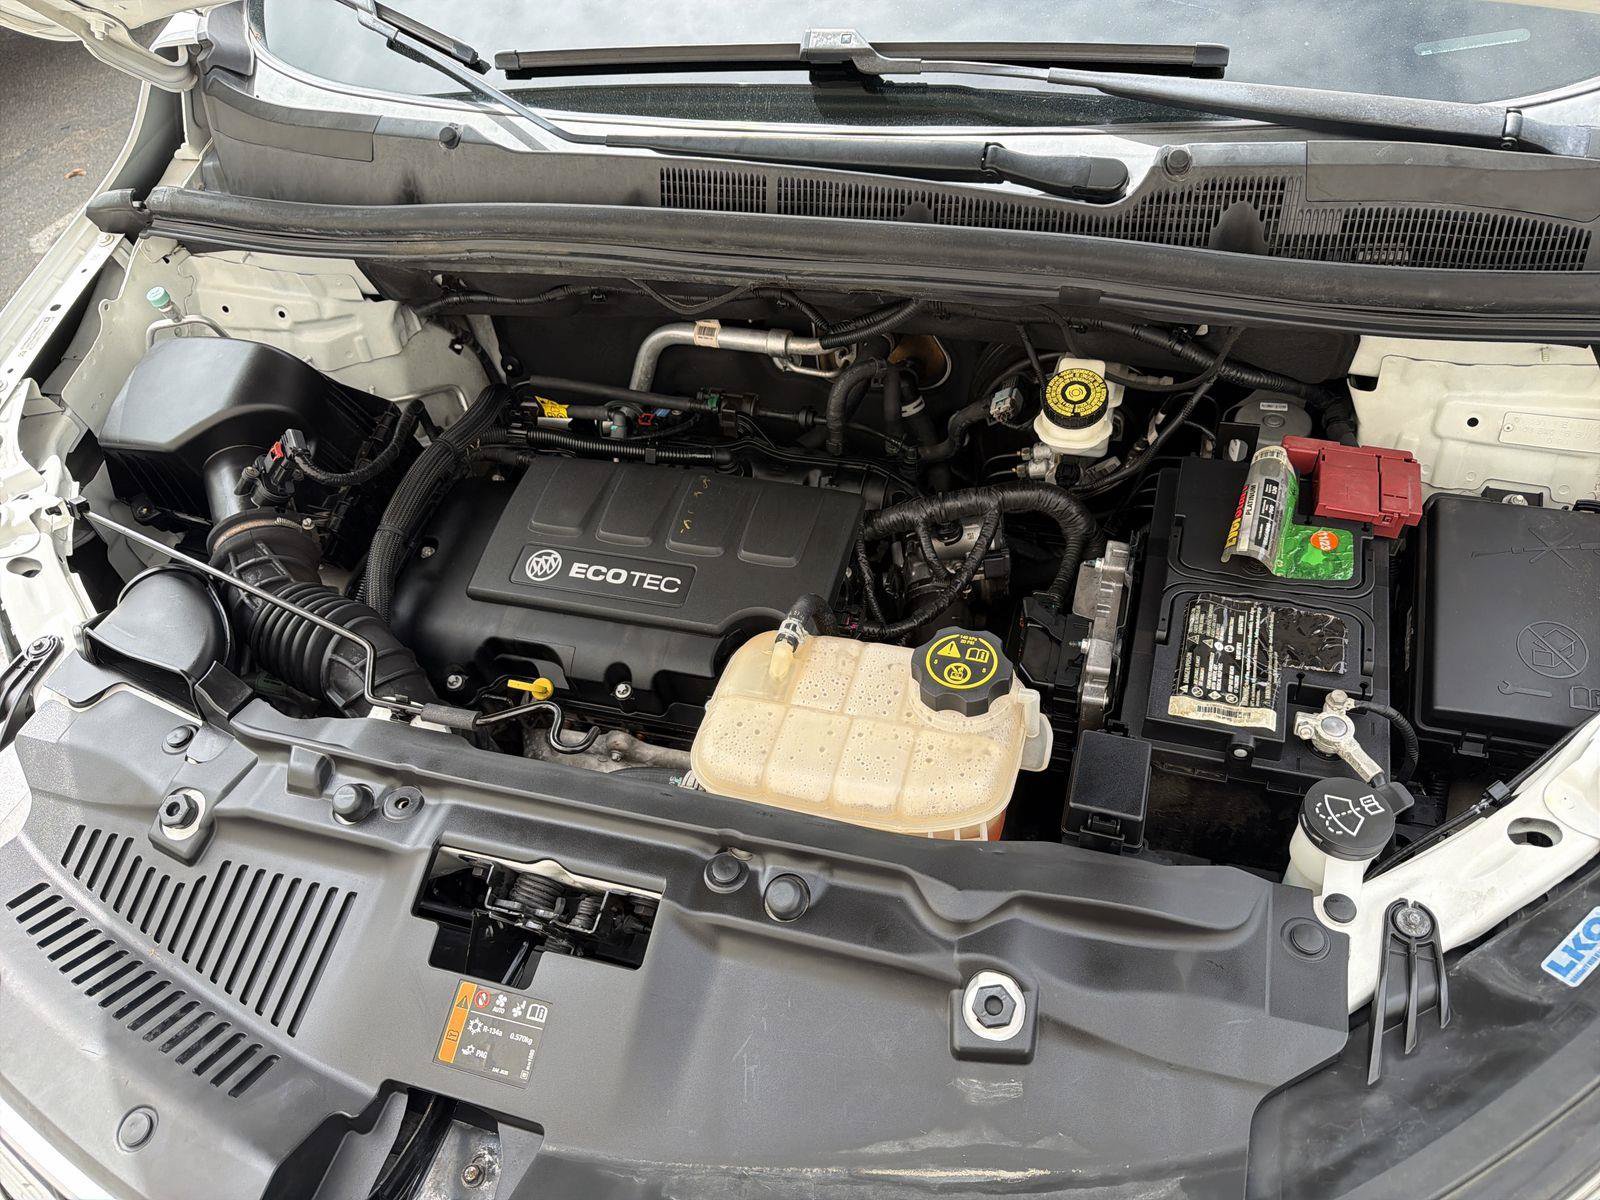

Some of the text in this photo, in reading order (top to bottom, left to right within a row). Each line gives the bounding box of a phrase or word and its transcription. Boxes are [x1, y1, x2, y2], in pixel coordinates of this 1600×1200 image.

[1245, 484, 1257, 516] PLATINUM
[568, 562, 682, 594] ECOTEC
[483, 1025, 533, 1046] R-134a 0.570kg
[475, 1049, 488, 1059] PAG
